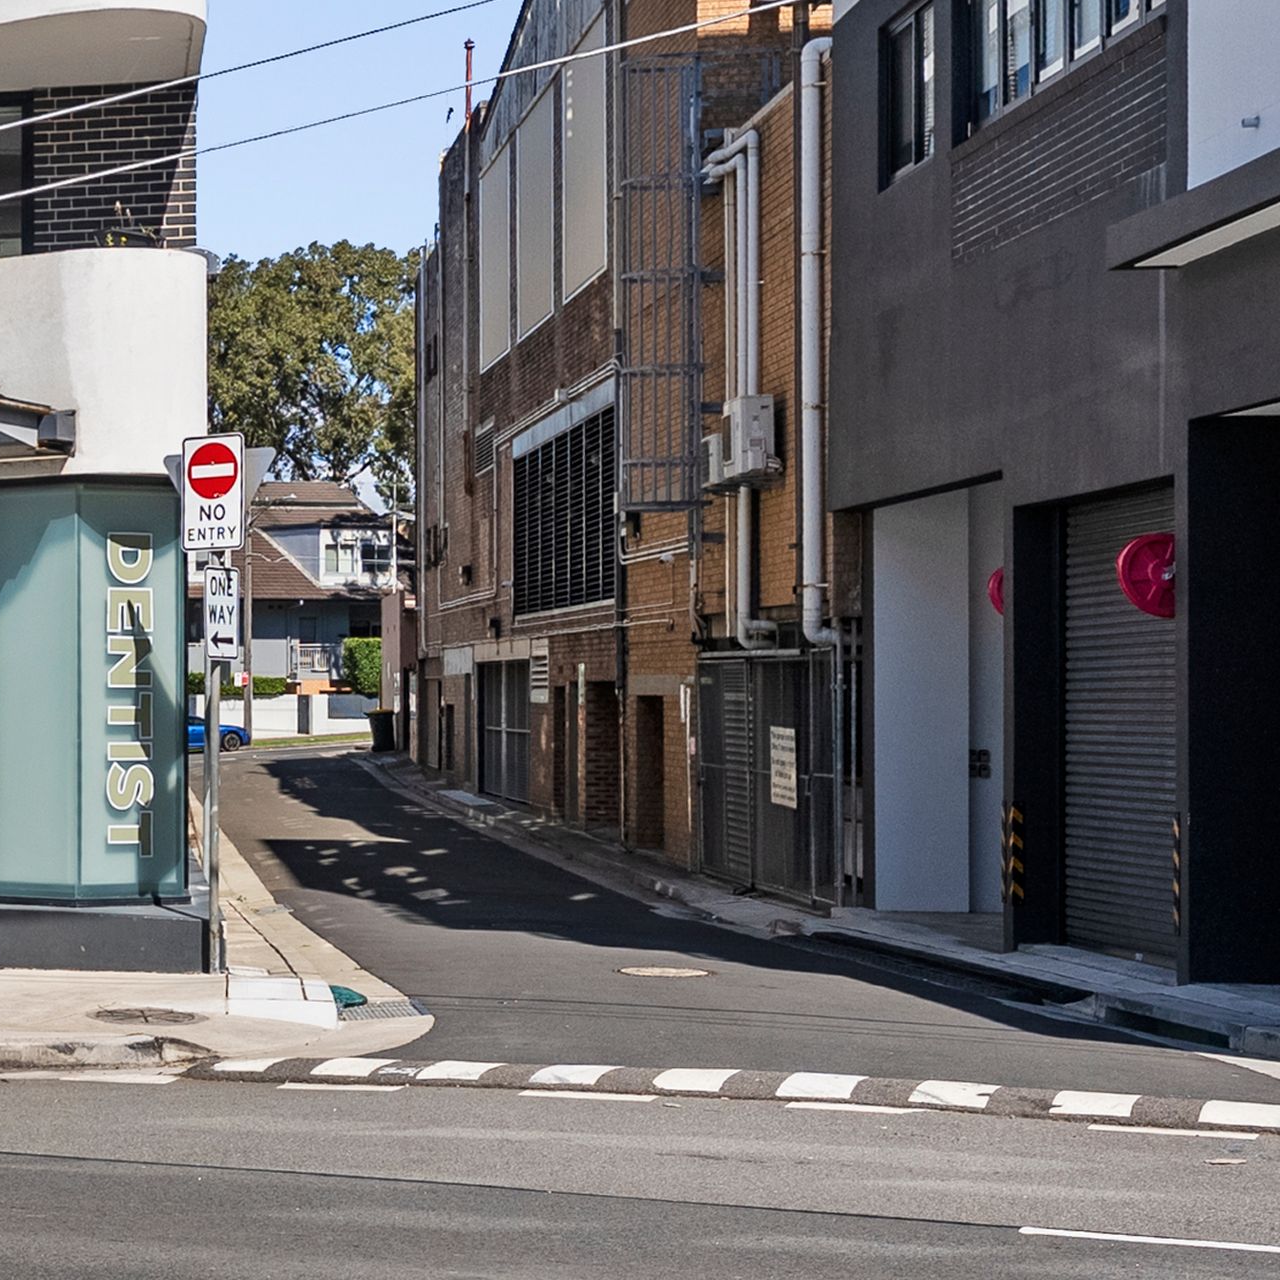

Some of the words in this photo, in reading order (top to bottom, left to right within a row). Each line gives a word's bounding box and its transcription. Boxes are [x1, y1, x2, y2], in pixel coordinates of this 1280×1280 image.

[199, 504, 226, 521] NO
[187, 526, 237, 542] ENTRY
[210, 576, 234, 597] ONE
[208, 604, 235, 626] WAY
[106, 532, 154, 858] DENTIST
